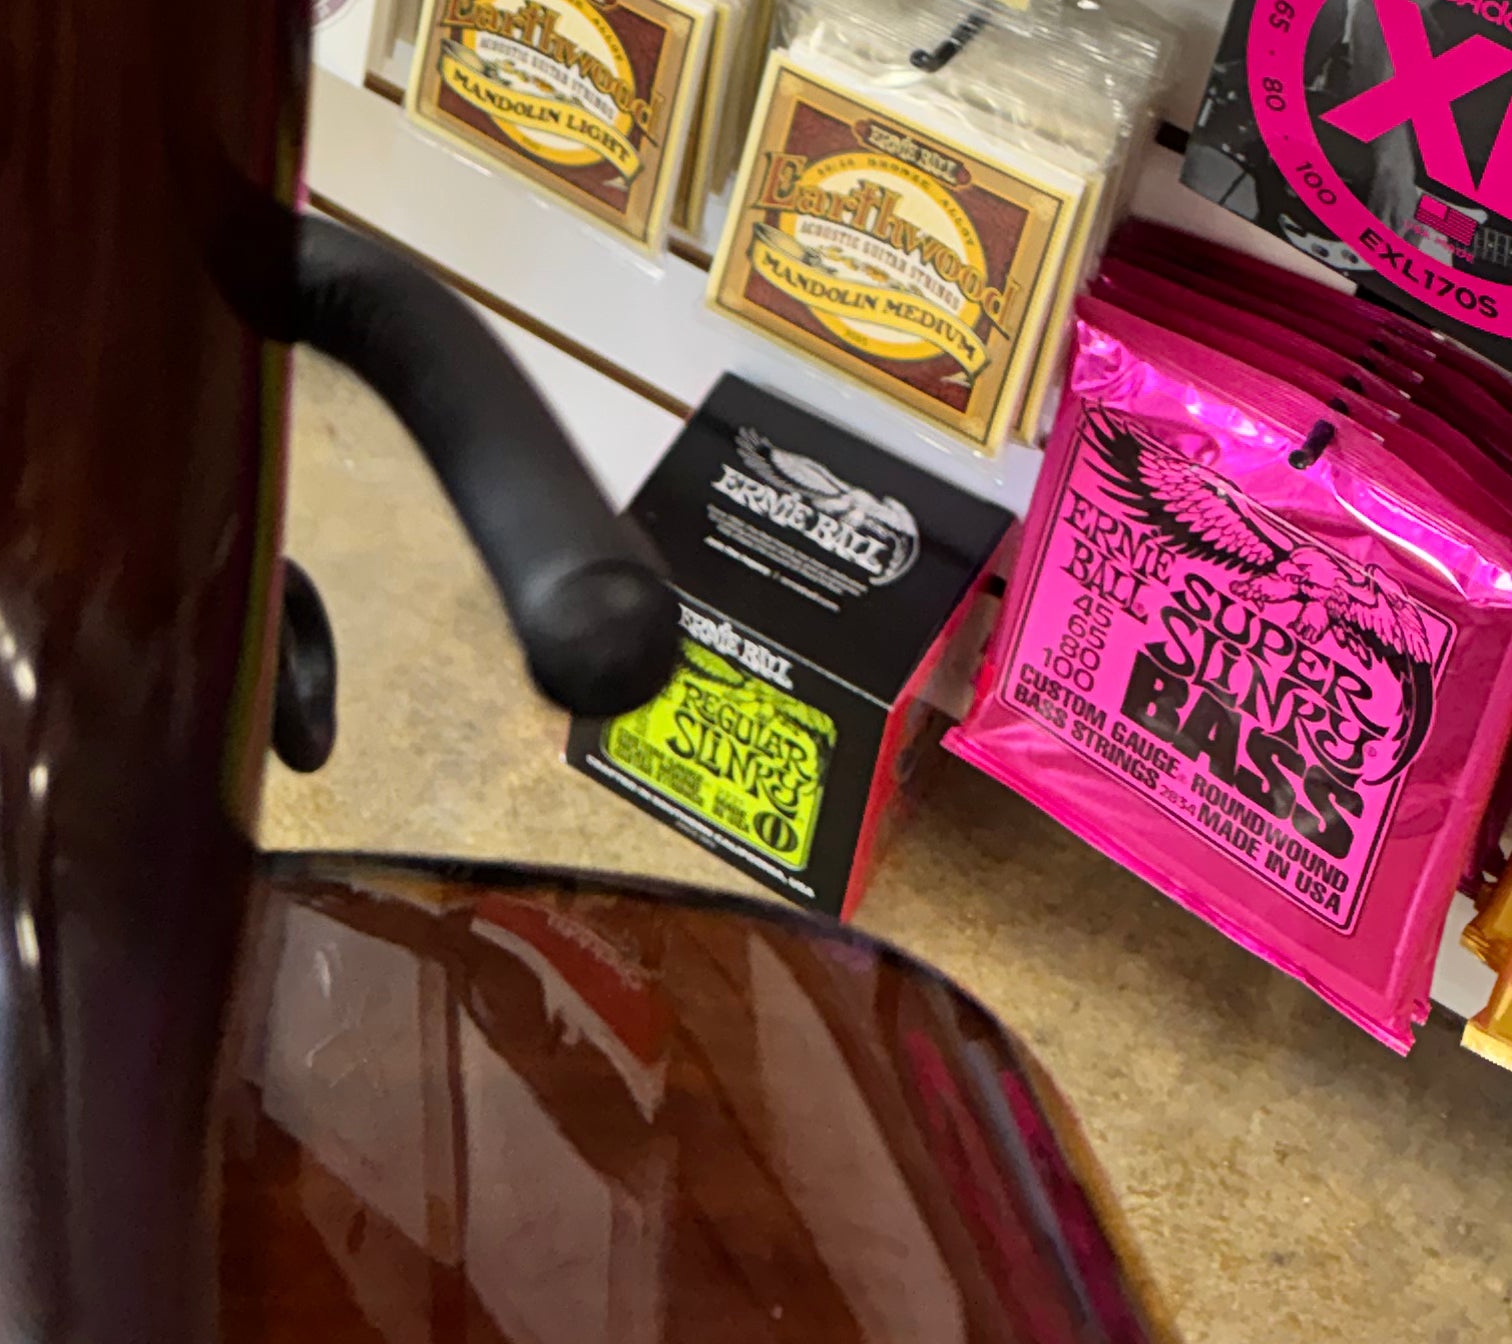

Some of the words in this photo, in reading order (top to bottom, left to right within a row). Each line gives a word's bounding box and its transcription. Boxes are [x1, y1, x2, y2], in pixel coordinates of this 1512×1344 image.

[1268, 0, 1296, 33] 65
[452, 68, 561, 123] MANDOLIN
[565, 112, 633, 164] LIGHT
[1262, 77, 1286, 112] 80
[1295, 161, 1338, 206] 100
[753, 151, 1023, 341] Earthwood
[1358, 228, 1500, 320] EXL170S
[761, 253, 878, 311] MANDOLIN
[881, 296, 979, 361] MEDIUM
[711, 463, 812, 531] ERNIE
[808, 511, 889, 576] BALL
[1062, 489, 1179, 587] ERNIE
[1066, 544, 1148, 625] BALL
[1067, 612, 1107, 651] 65
[1071, 593, 1114, 631] 45
[1040, 645, 1098, 693] 100
[1060, 630, 1103, 673] 80
[1172, 589, 1376, 713] SUPER
[682, 682, 813, 779] REGULAR
[1013, 682, 1068, 741] BASS
[1066, 719, 1163, 794] STRINGS
[1158, 618, 1393, 788] SLINKY
[665, 712, 823, 819] SLINKY
[1018, 661, 1109, 727] CUSTOM
[1108, 716, 1181, 780] GAUGE
[1189, 771, 1351, 894] ROUNDWOUND
[1120, 642, 1368, 862] BASS
[1196, 802, 1265, 869] MADE
[1262, 852, 1292, 887] IN
[1288, 867, 1344, 916] USA
